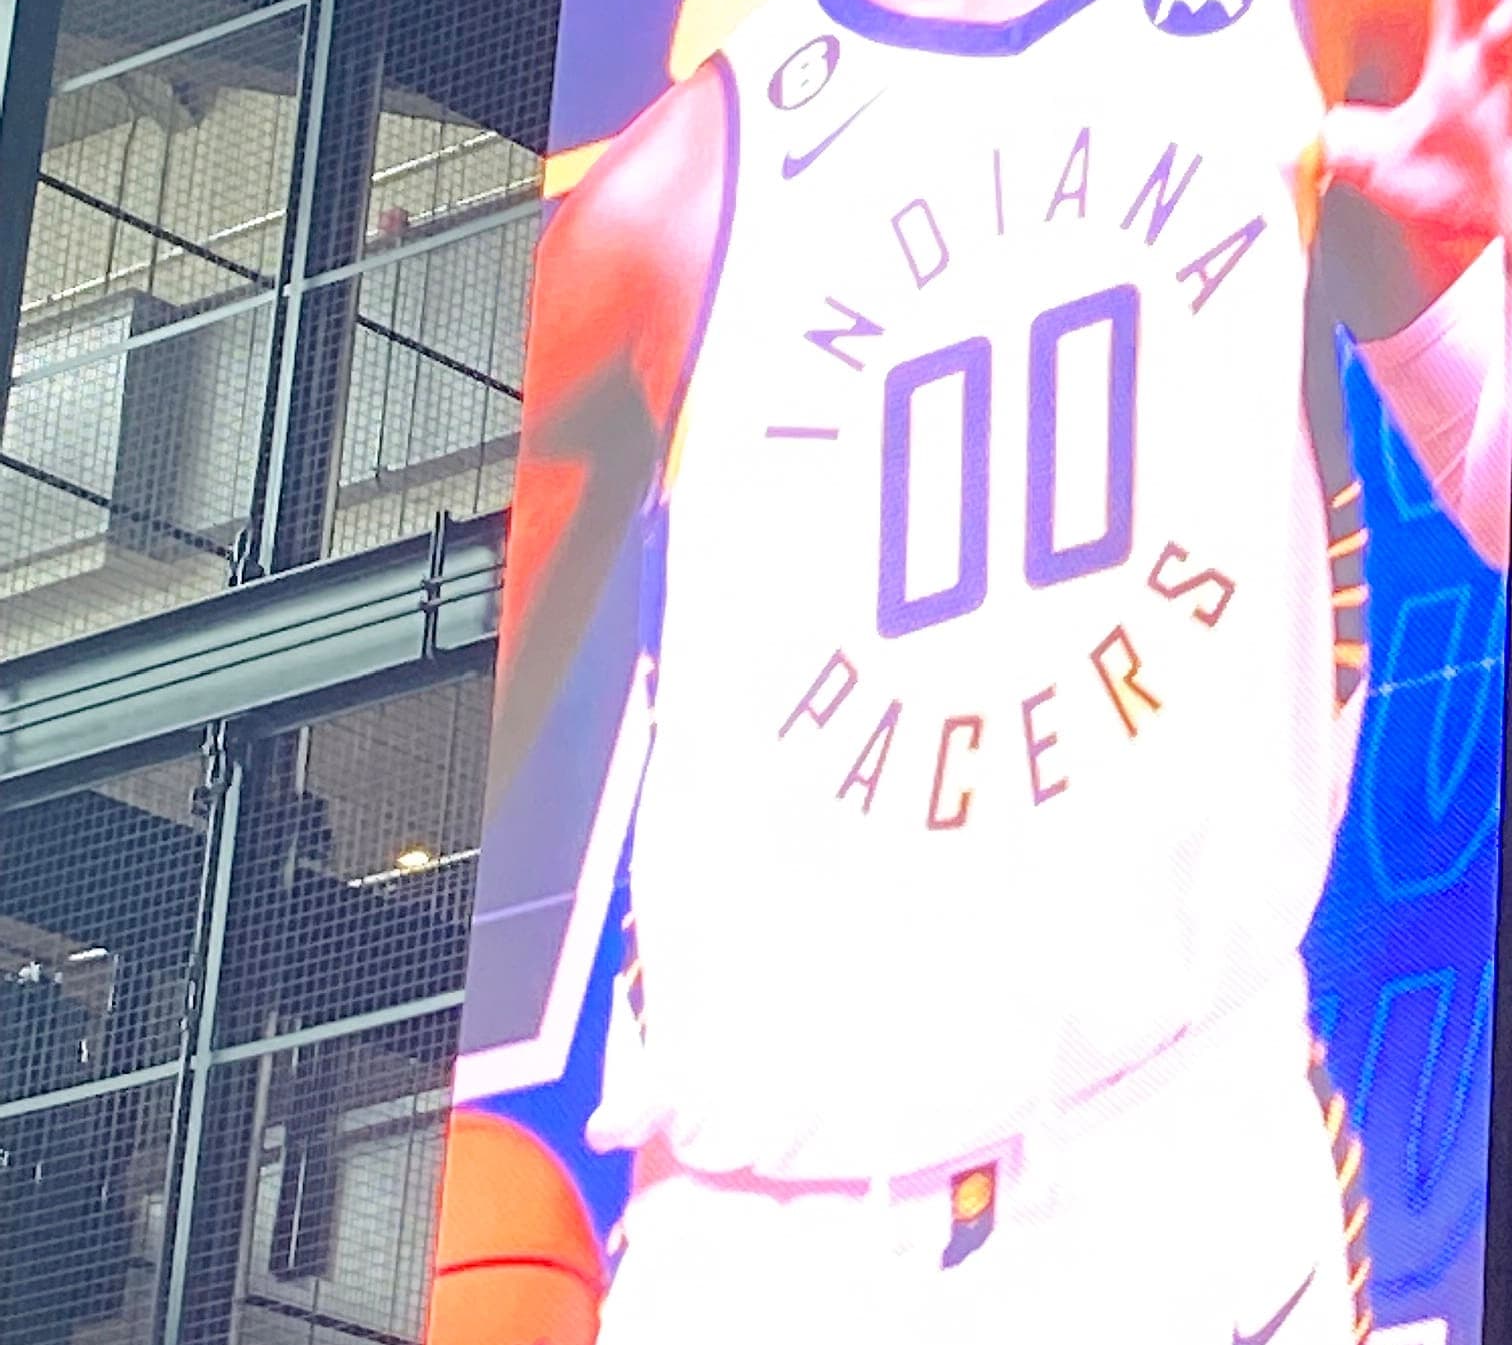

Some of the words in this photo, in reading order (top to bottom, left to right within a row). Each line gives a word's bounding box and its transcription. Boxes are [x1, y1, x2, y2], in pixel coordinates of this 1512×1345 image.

[766, 127, 1267, 439] INDIANA
[876, 282, 1140, 639] 00
[779, 542, 1235, 831] PACERS
